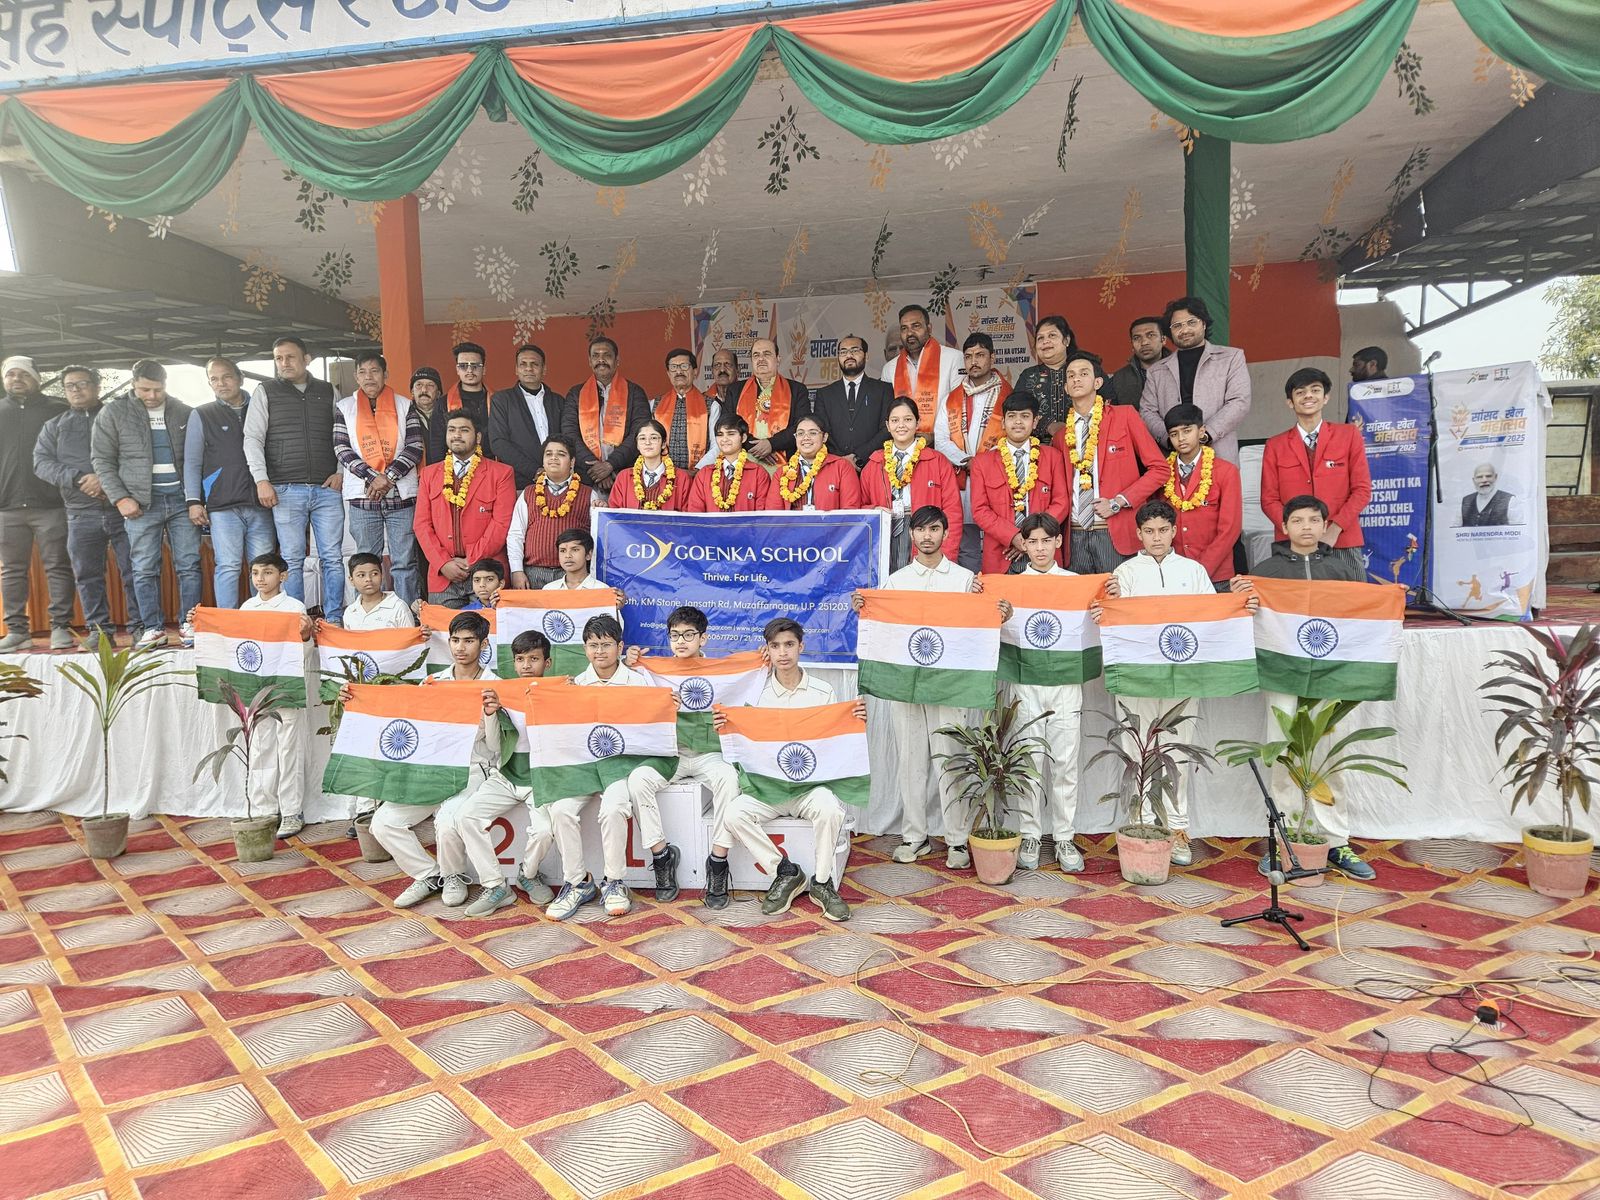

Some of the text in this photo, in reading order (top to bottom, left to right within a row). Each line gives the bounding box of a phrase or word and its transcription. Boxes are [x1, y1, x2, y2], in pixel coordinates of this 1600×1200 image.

[810, 334, 838, 358] सांसद
[1471, 406, 1525, 422] सांसद खेल
[1366, 418, 1416, 433] सांसद खेल
[1481, 417, 1527, 433] महोत्सव
[1374, 428, 1418, 443] महोत्सव
[1506, 434, 1526, 443] 2025
[1400, 443, 1417, 452] 2025
[1371, 477, 1421, 490] SHAKTI KA
[1390, 503, 1414, 514] KHEL
[626, 543, 849, 563] GD GOENKA SCHOOL
[702, 572, 770, 583] Thrive. For Life.
[641, 598, 655, 607] KM
[683, 599, 716, 608] Jansath
[718, 600, 732, 609] Rd,
[733, 600, 799, 611] Muzaffarnagar,
[800, 602, 816, 611] U.P.
[818, 602, 849, 611] 251203
[485, 816, 515, 865] 2
